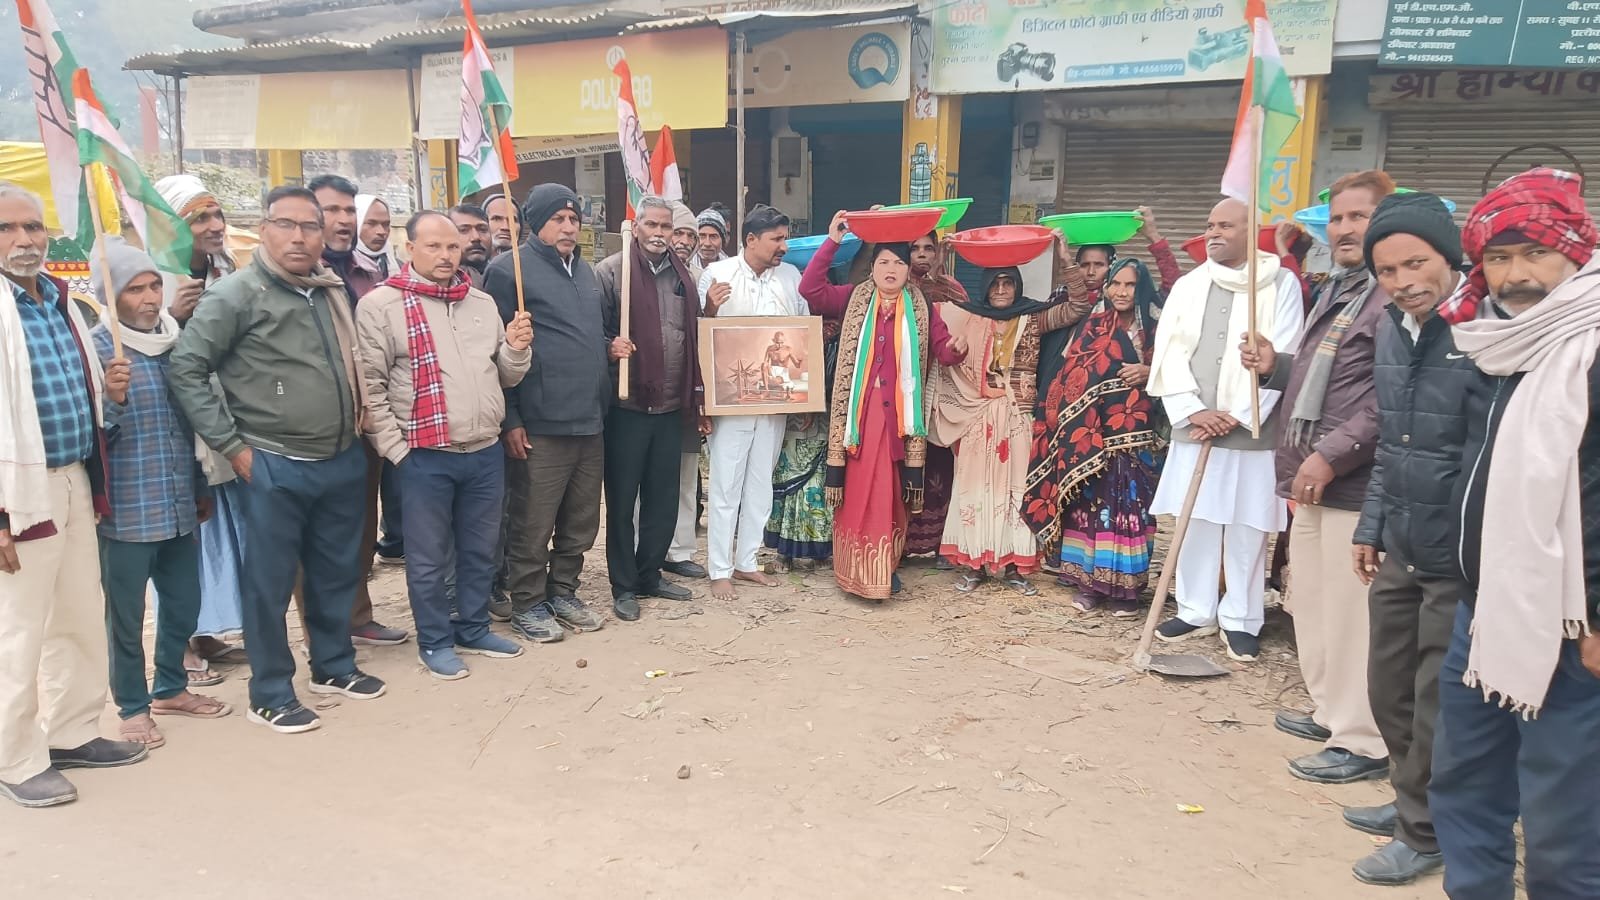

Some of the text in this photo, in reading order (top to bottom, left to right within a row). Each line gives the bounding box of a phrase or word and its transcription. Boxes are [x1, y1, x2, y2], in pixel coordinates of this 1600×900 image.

[1394, 2, 1408, 13] पूर्व
[1022, 17, 1066, 33] डिजिटल
[1070, 14, 1097, 29] फोटो
[1099, 11, 1129, 28] ग्राफी
[1150, 6, 1190, 23] वीडियो
[1193, 5, 1225, 21] ग्राफी
[1526, 16, 1550, 24] समय
[1389, 27, 1424, 37] सोमवार
[1436, 27, 1472, 37] शनिवार
[521, 148, 561, 161] ELECTRICALS
